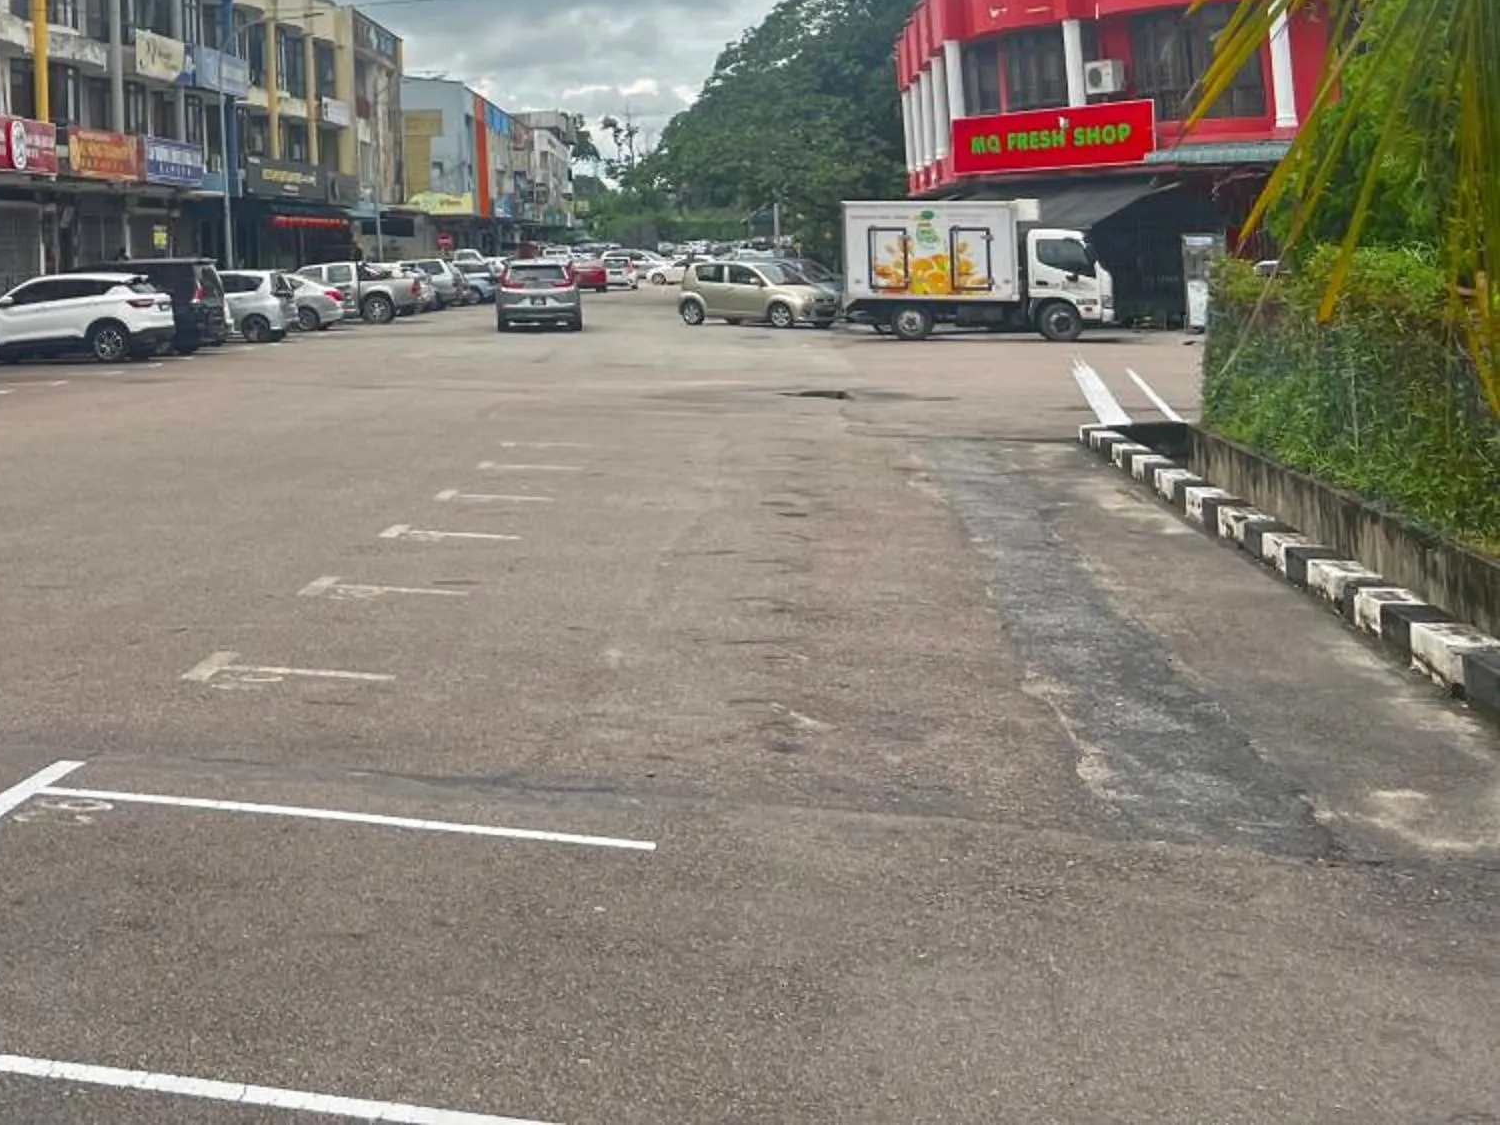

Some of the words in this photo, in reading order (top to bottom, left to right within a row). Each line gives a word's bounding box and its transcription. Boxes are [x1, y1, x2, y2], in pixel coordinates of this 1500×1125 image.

[970, 135, 1000, 154] MQ
[1007, 129, 1066, 151] FRESH
[1073, 123, 1132, 146] SHOP
